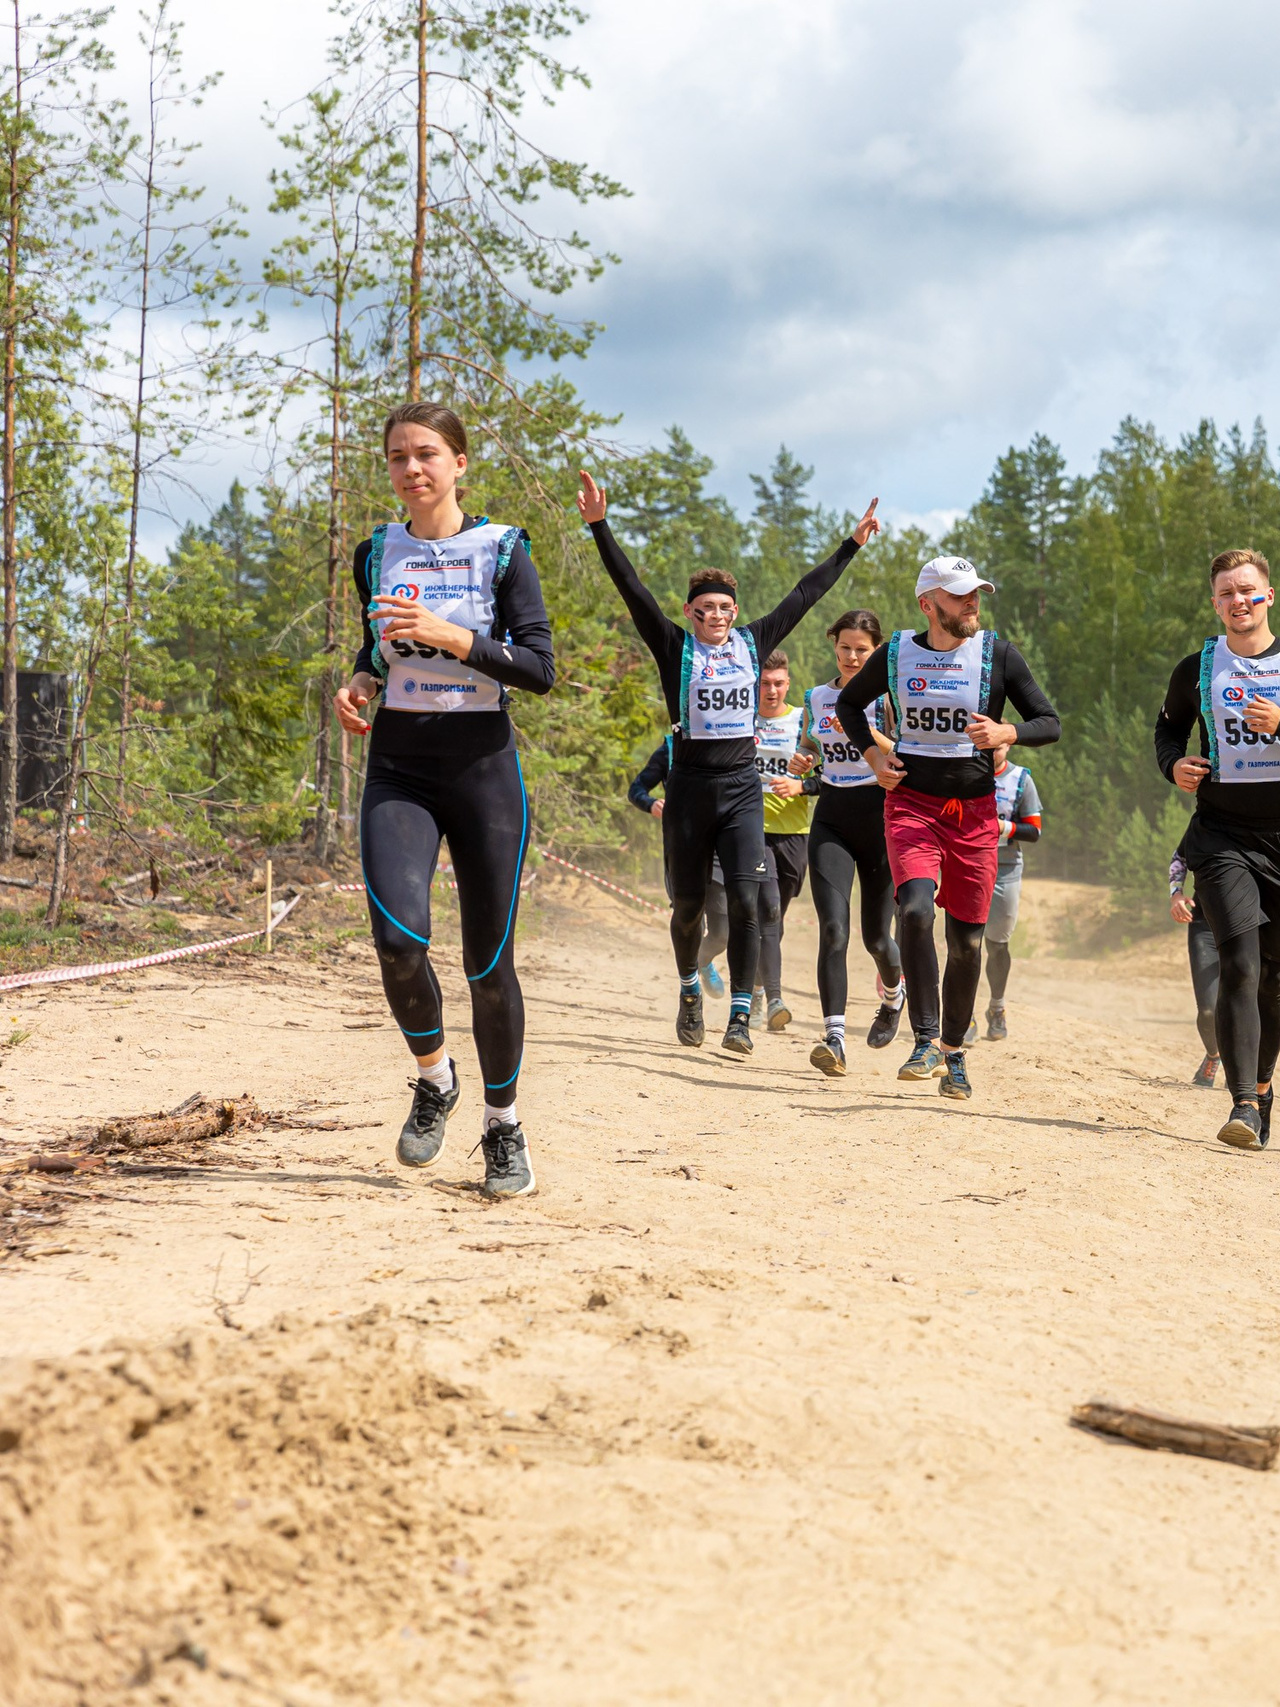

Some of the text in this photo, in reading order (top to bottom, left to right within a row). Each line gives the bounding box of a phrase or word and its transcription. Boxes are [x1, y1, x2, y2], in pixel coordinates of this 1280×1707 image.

[405, 558, 471, 569] ГОНКА ГЕРОЕВ
[424, 584, 481, 593] ИНЖЕНЕРНЫЕ
[423, 591, 464, 600] СИСТЕМЫ
[421, 681, 477, 693] ГАЗПРОМБАНК
[929, 679, 969, 687] ИНЖЕНЕРНЫЕ
[697, 687, 750, 711] 5949
[906, 706, 968, 733] 5956
[823, 741, 861, 763] 596
[754, 757, 788, 775] 948
